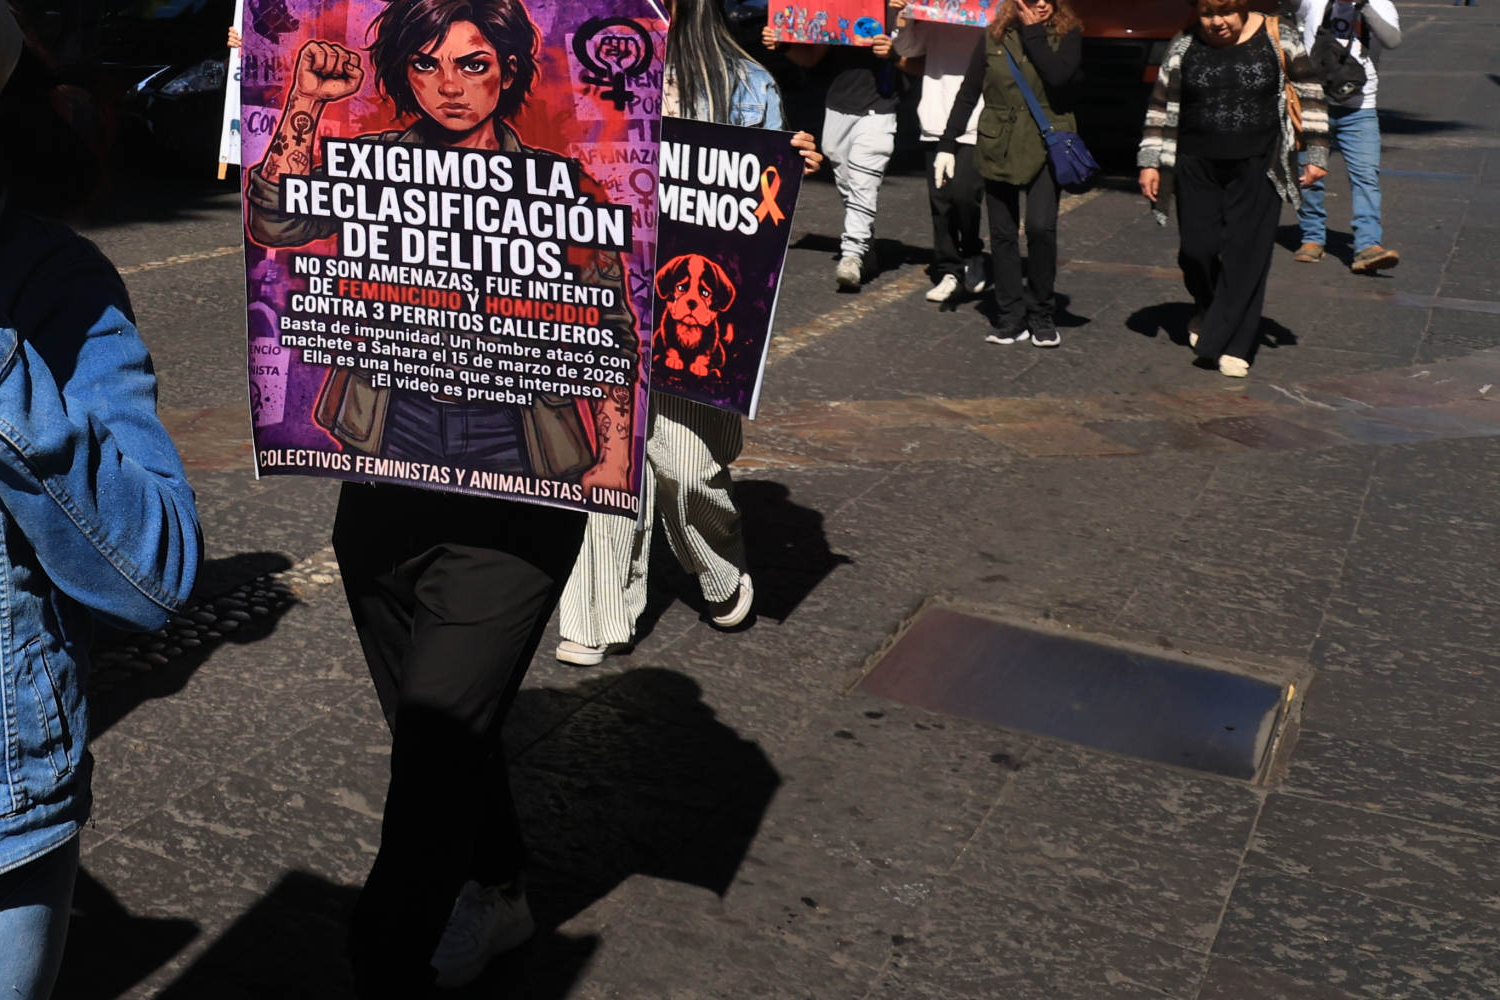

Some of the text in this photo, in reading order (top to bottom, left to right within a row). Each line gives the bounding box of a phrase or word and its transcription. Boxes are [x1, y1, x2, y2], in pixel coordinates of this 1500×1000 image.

[326, 141, 575, 199] EXIGIMOS LA
[659, 141, 689, 182] NI
[697, 147, 761, 192] UNO
[285, 178, 625, 247] RECLASIFICACIÓN
[658, 183, 759, 236] MENOS
[342, 221, 574, 281] DE DELITOS.
[295, 256, 615, 308] NO SON AMENAZAS, FUE INTENTO
[309, 277, 600, 326] DE FEMINICIDIO Y HOMICIDIO
[280, 317, 631, 370] Basta de impunidad. Un hombre atacó con
[291, 295, 620, 349] CONTRA 3 PERRITOS CALLEJEROS.
[281, 334, 630, 386] machete a Sahara el 15 de marzo de 2026.
[303, 349, 607, 399] Ella es una heroína que se interpuso.
[371, 373, 533, 406] ¡El video es prueba!
[260, 450, 639, 513] COLECTIVOS FEMINISTAS Y ANIMALISTAS, UNIDO
